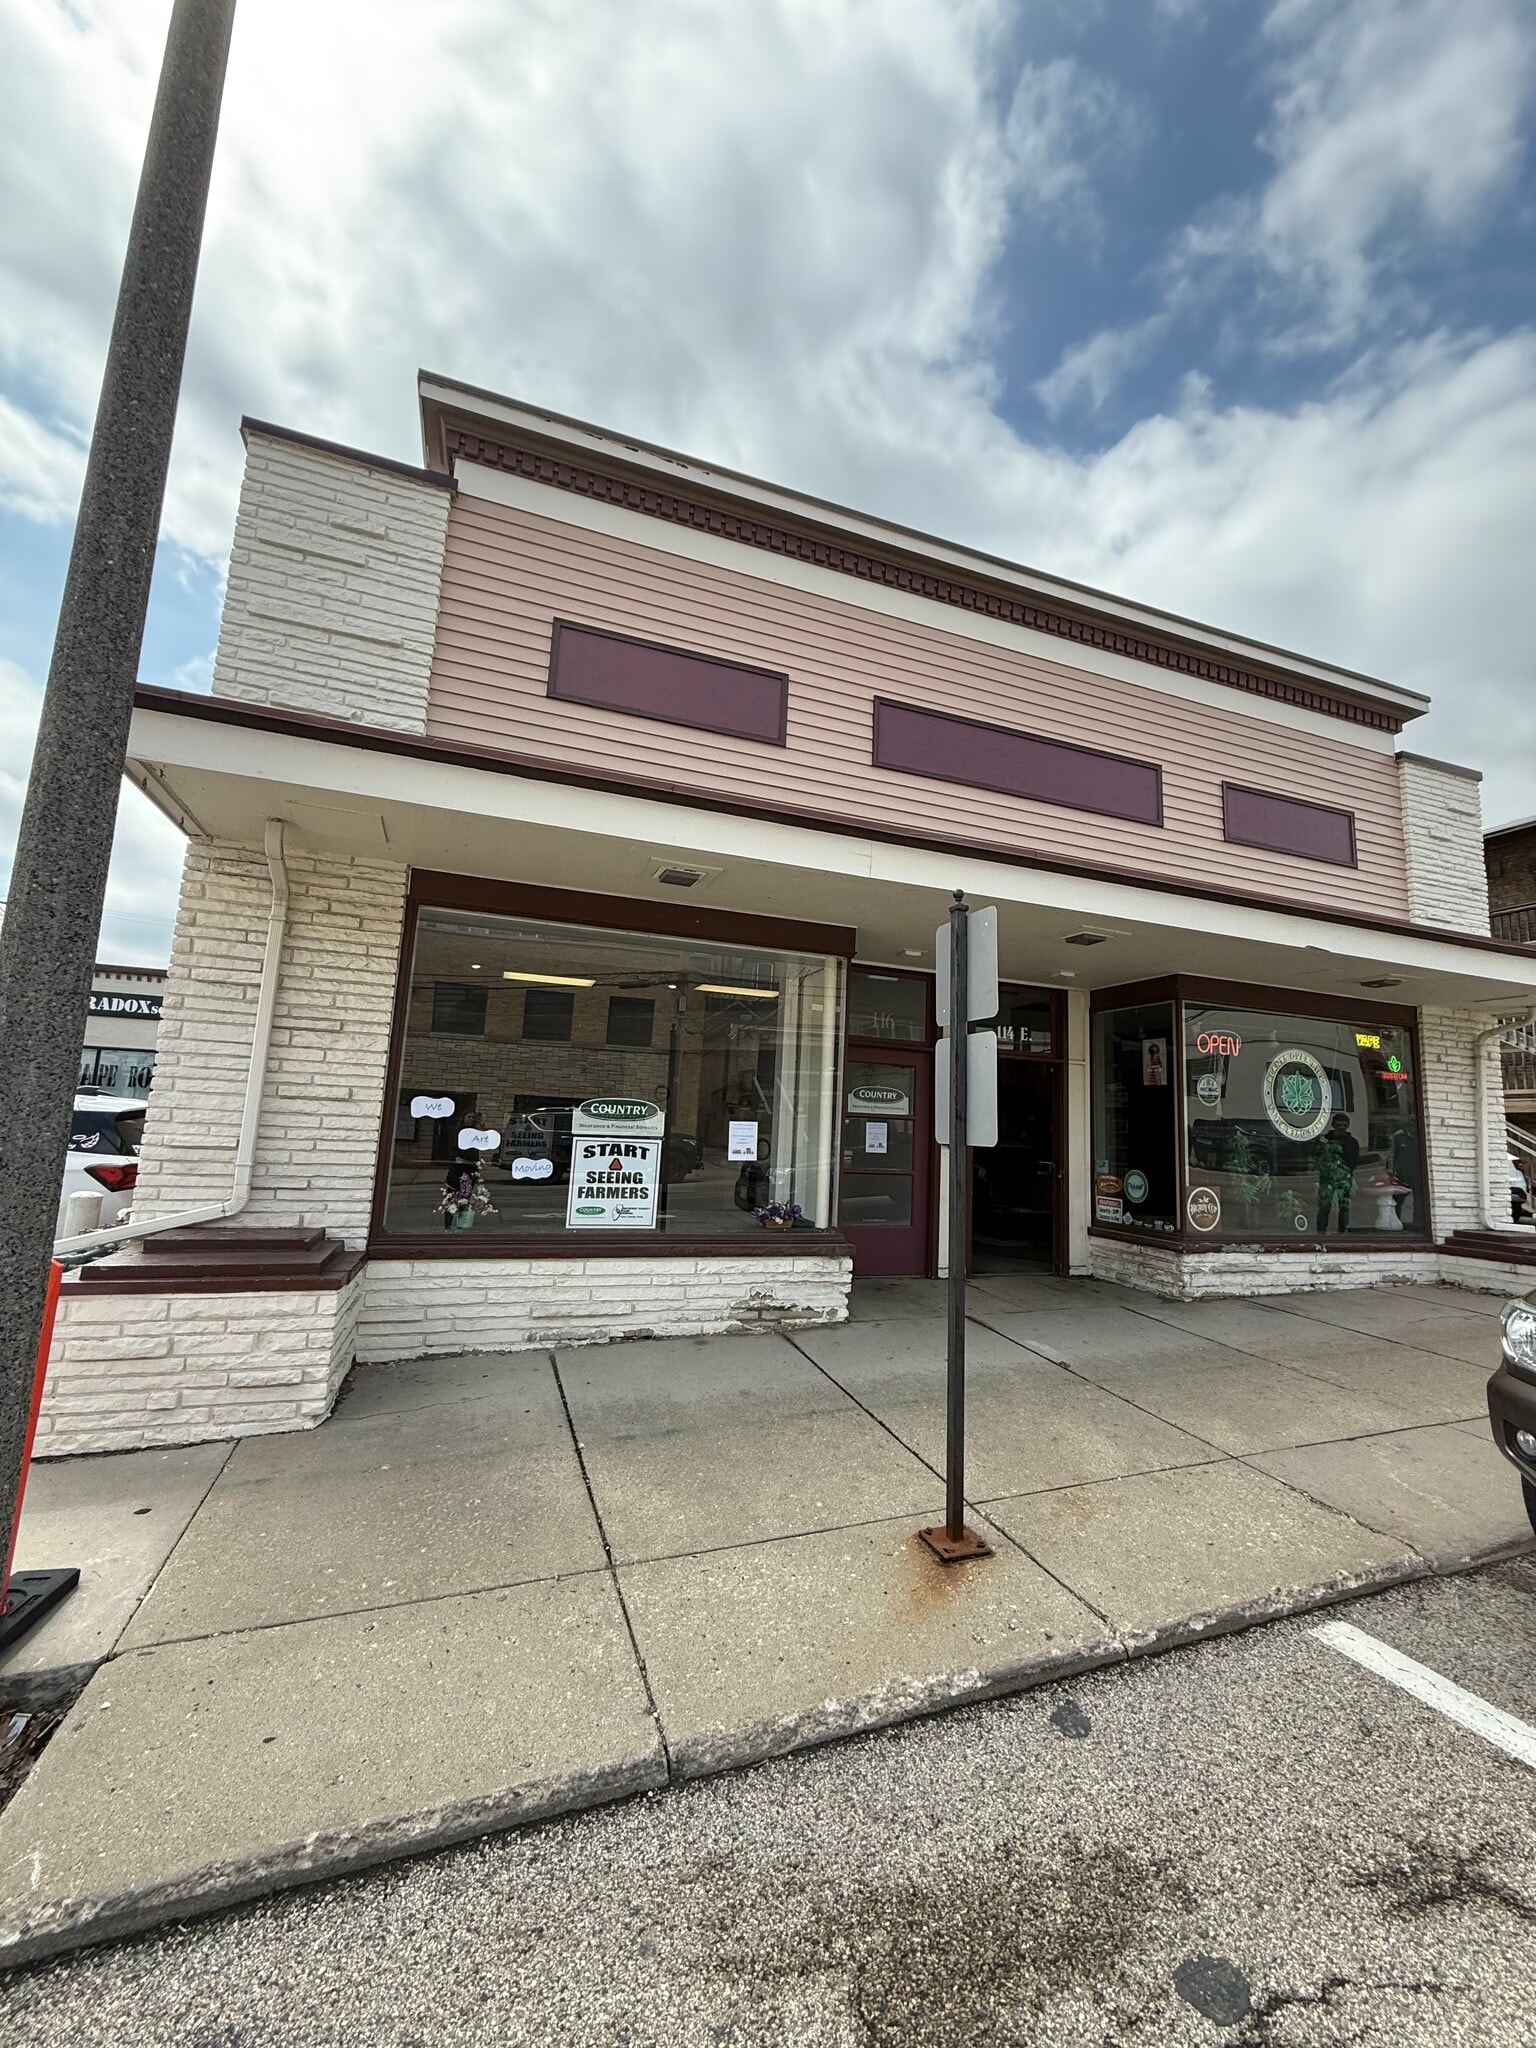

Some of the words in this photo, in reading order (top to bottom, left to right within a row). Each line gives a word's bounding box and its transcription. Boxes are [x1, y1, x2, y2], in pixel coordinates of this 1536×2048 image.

[873, 1011, 895, 1029] 116
[997, 1025, 1015, 1040] 114
[1197, 1033, 1240, 1057] OPEN
[1355, 1033, 1380, 1049] VAPE
[1267, 1055, 1288, 1082] PLANTS
[1290, 1053, 1309, 1063] OVER
[78, 1063, 119, 1087] APE
[859, 1089, 898, 1100] COUNTRY
[425, 1103, 442, 1111] We
[590, 1103, 648, 1115] COUNTRY
[471, 1134, 489, 1143] Are
[1286, 1127, 1307, 1137] OVER
[583, 1143, 650, 1161] START
[514, 1162, 552, 1174] Moving
[586, 1171, 644, 1185] SEEING
[577, 1186, 649, 1200] FARMERS
